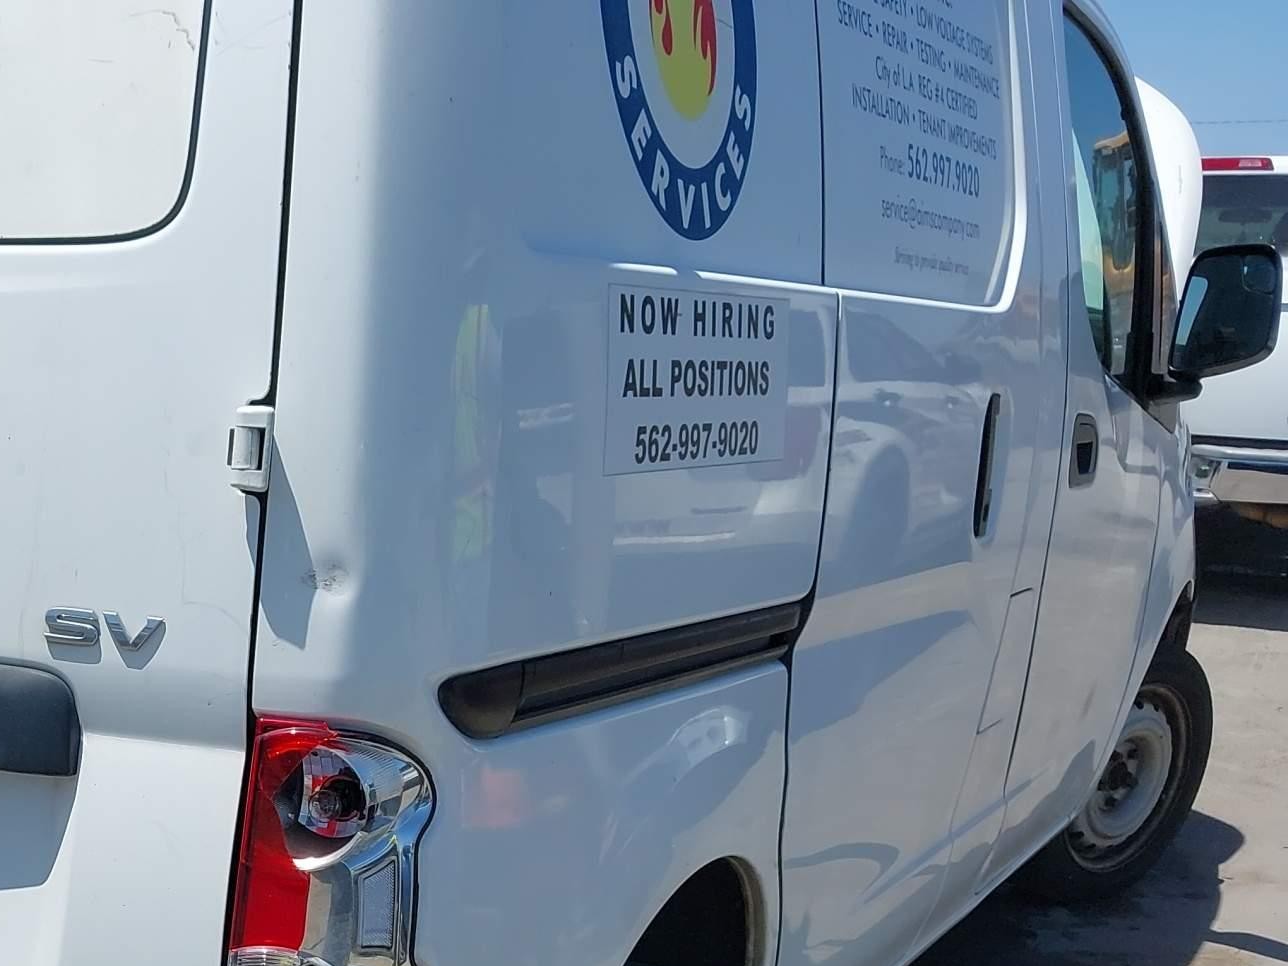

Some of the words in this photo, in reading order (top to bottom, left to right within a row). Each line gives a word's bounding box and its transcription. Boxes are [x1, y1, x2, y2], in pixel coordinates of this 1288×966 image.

[837, 0, 873, 38] SERVICE
[881, 20, 908, 54] REPAIR
[915, 37, 946, 73] TESTING
[953, 58, 1000, 99] MAINTENANCE
[915, 4, 934, 32] LOW
[935, 15, 964, 50] VOLTAGE
[875, 56, 891, 88] City
[893, 63, 900, 86] of
[614, 55, 752, 230] SERVICES
[852, 84, 910, 126] INSTALLATION
[918, 109, 946, 140] TENANT
[948, 122, 997, 160] IMPROVEMENTS
[907, 143, 980, 198] 562.997.9020
[620, 293, 680, 336] NOW
[693, 299, 775, 340] HIRING
[622, 358, 664, 398] ALL
[670, 359, 770, 398] POSITIONS
[634, 420, 759, 465] 562-997-9020
[43, 606, 166, 653] SV
